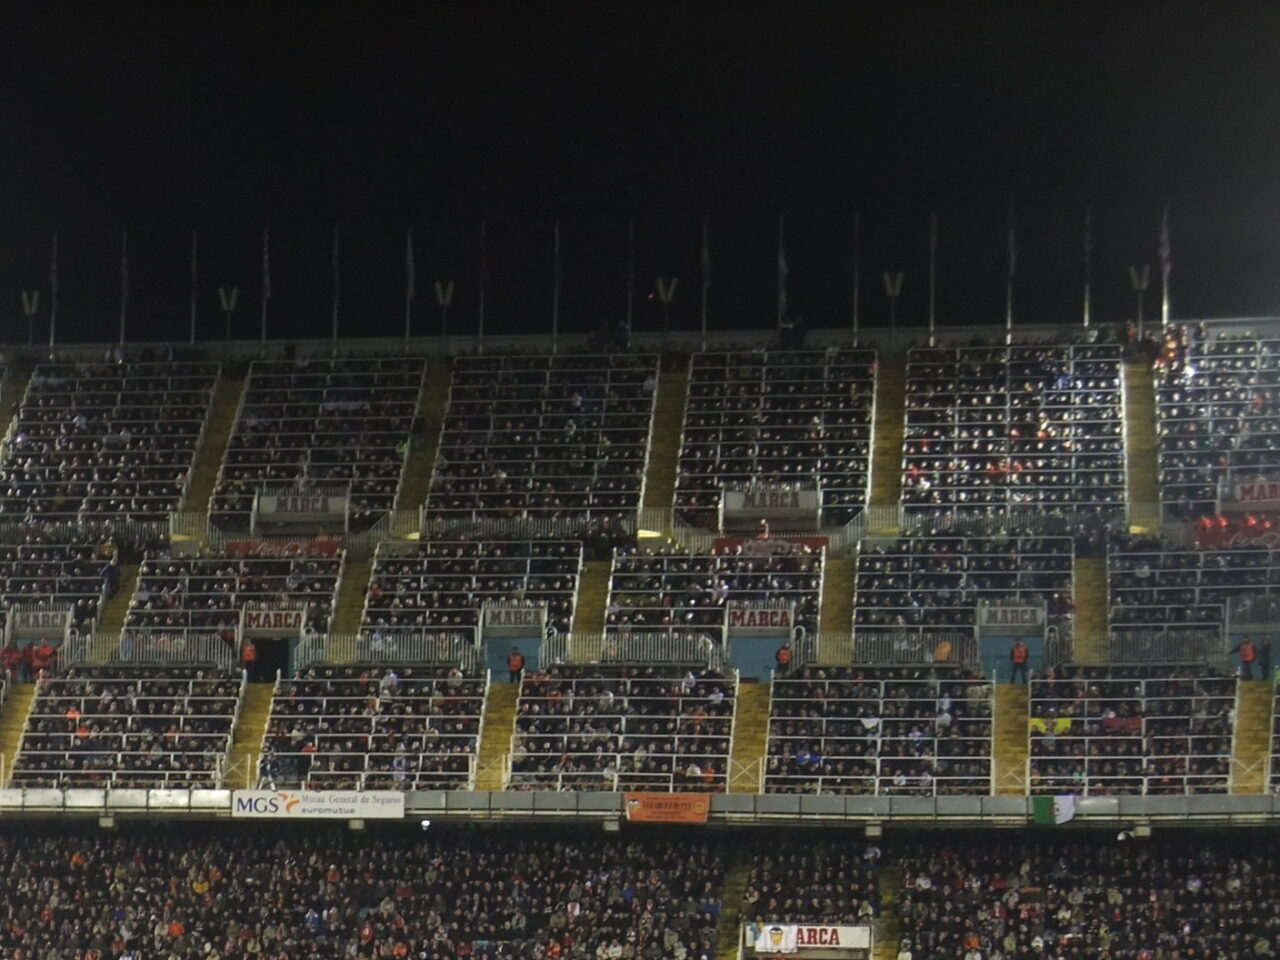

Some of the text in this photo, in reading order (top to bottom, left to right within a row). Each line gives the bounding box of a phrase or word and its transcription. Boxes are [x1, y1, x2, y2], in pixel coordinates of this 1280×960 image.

[248, 612, 302, 629] MARCA
[730, 610, 790, 628] MARCA
[236, 797, 279, 813] MGS
[796, 927, 841, 946] ARCA
